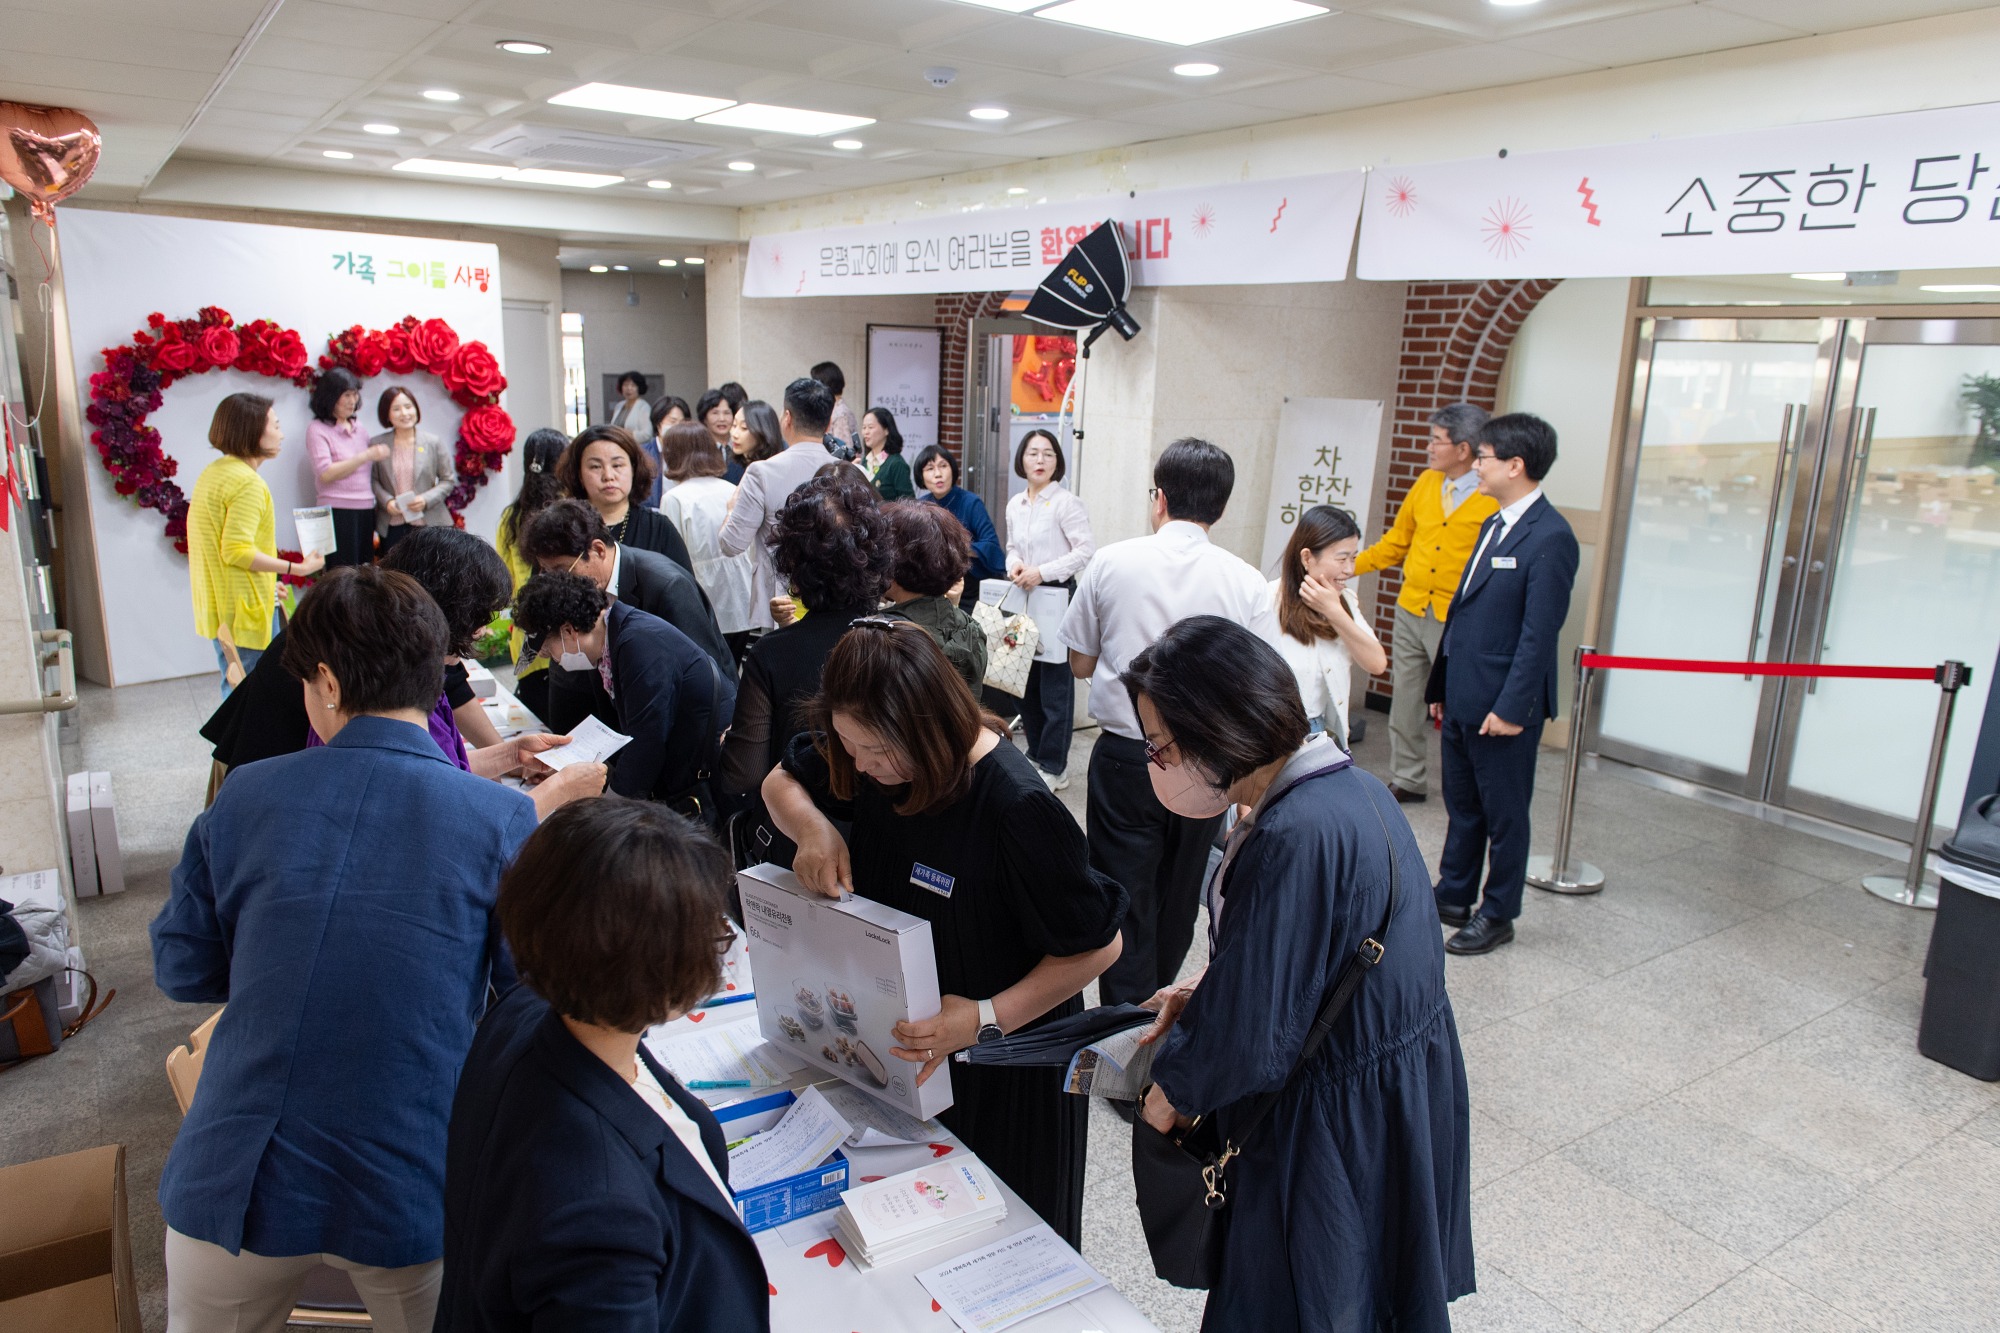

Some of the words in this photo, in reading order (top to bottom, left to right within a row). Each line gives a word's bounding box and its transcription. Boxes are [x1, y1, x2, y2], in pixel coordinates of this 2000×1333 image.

[1661, 163, 1877, 238] 소중한
[1902, 152, 2000, 225] 당
[820, 242, 898, 277] 은평교회에
[906, 238, 939, 273] 오신
[948, 230, 1031, 271] 여러분을
[1040, 218, 1172, 265] 환영니다
[332, 251, 376, 284] 가족
[454, 265, 490, 292] 사랑
[1067, 268, 1088, 287] FLIP
[890, 406, 933, 418] 그리스도
[1314, 445, 1342, 476] 차
[1298, 474, 1352, 506] 한잔
[915, 866, 930, 880] 새가족
[930, 872, 951, 888] 등록위원
